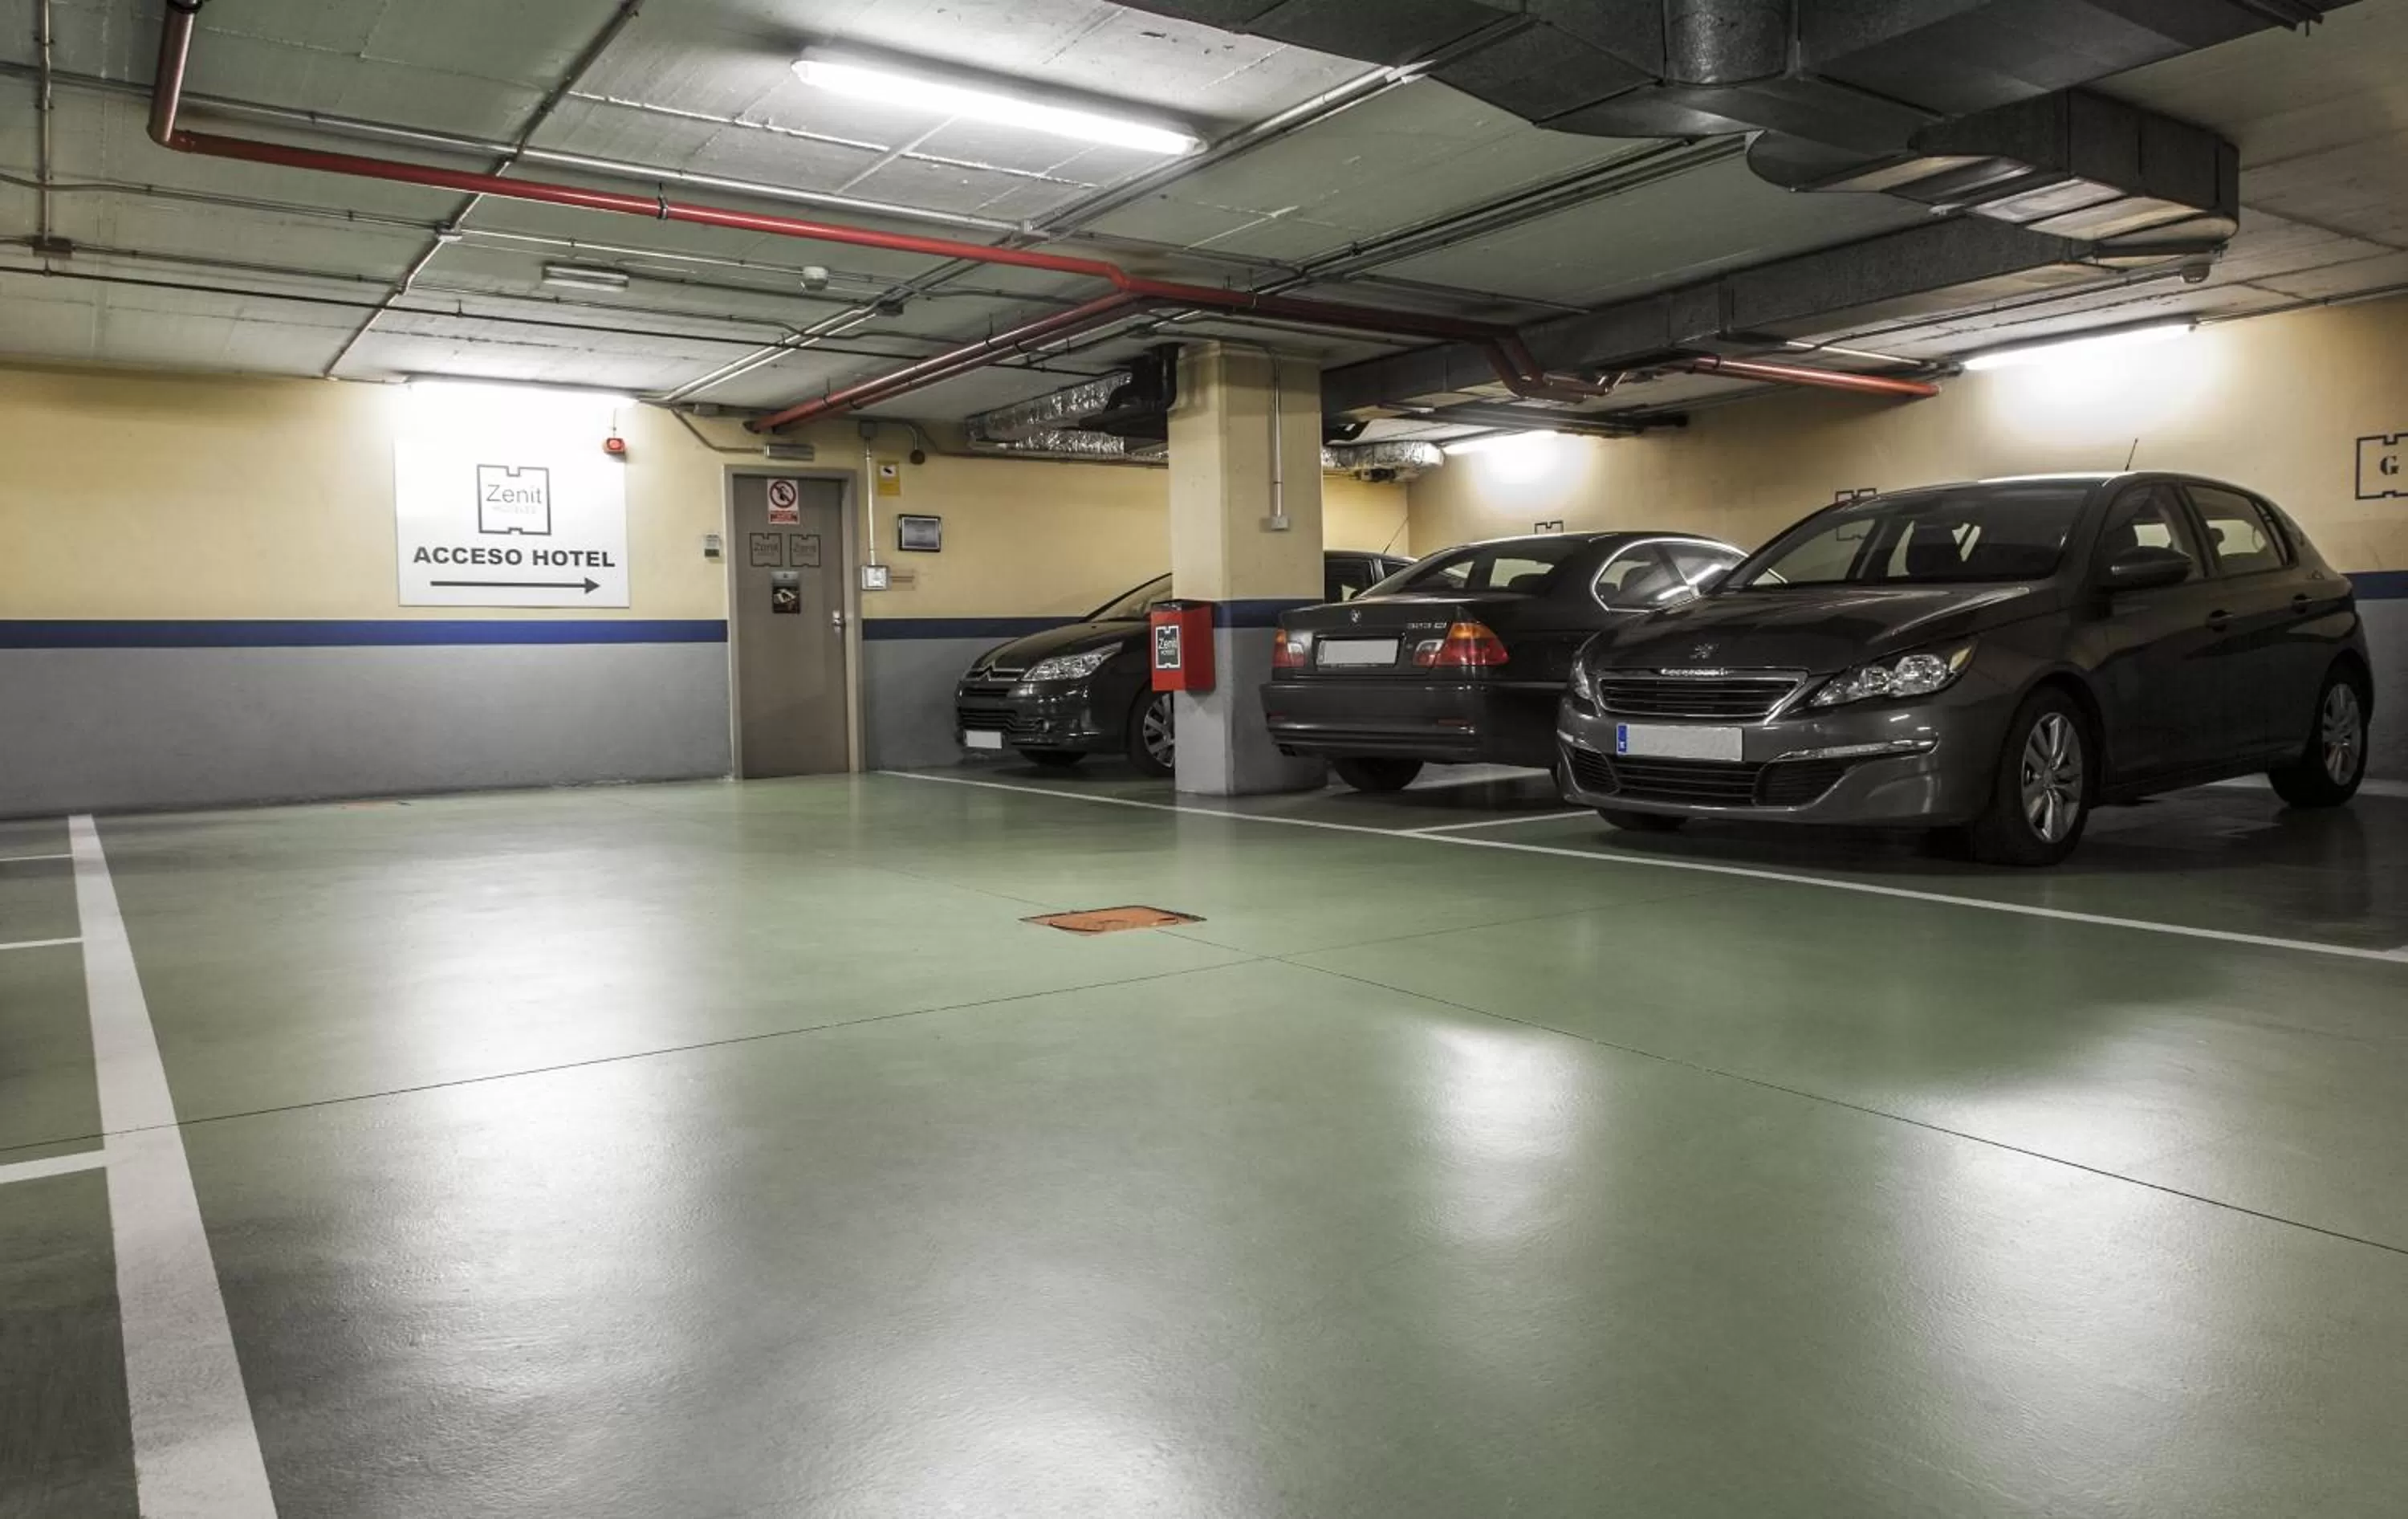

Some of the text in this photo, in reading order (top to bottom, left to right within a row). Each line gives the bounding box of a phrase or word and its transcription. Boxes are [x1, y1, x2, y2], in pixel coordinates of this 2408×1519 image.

[2380, 455, 2400, 475] G
[486, 484, 542, 504] Zenit
[413, 547, 616, 568] ACCESO HOTEL
